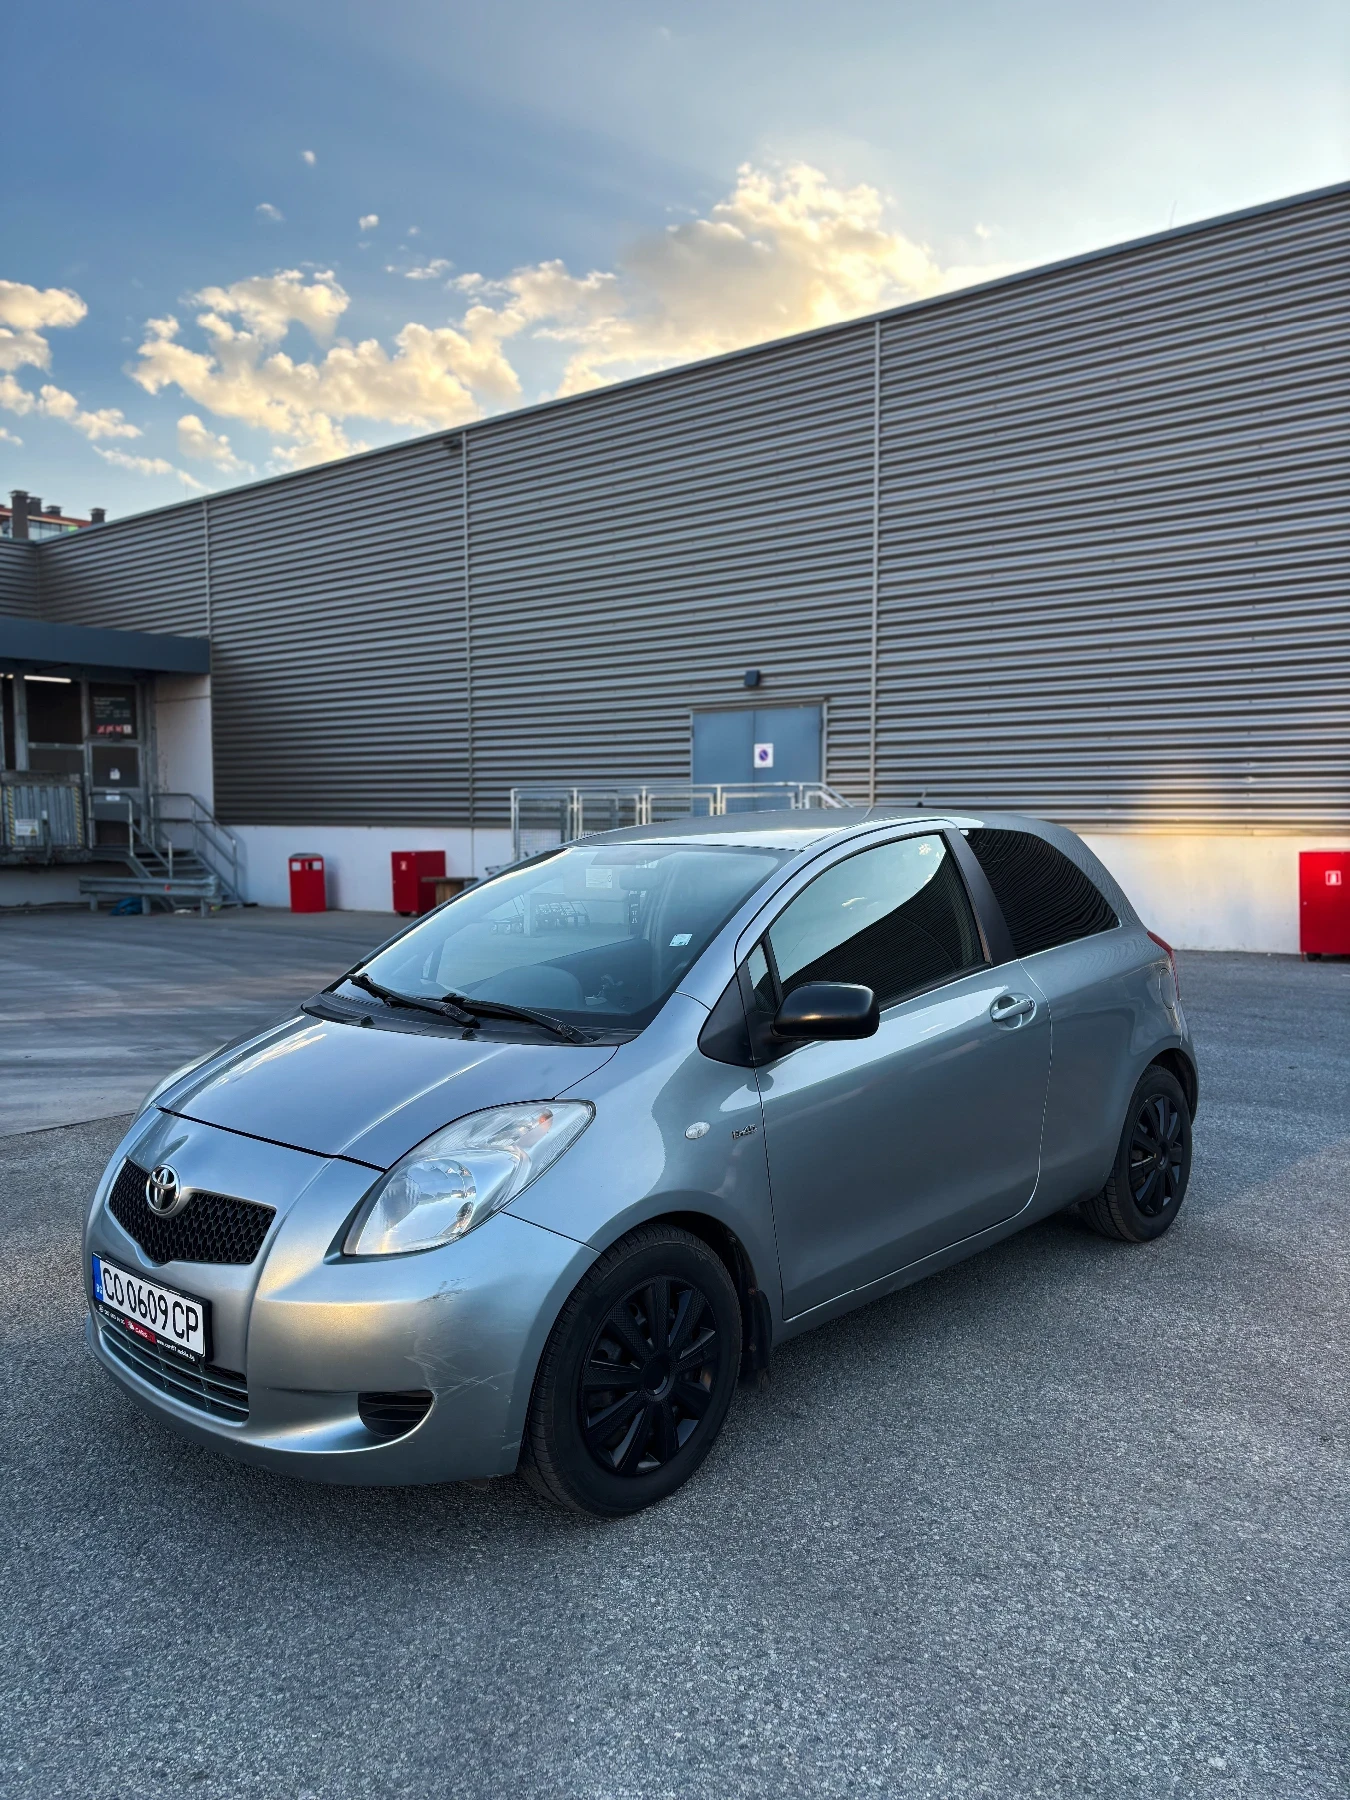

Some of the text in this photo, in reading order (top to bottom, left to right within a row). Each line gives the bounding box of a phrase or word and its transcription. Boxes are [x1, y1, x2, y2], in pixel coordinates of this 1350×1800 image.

[103, 1267, 124, 1307] CO
[127, 1280, 168, 1331] 0609
[172, 1300, 199, 1343] CP
